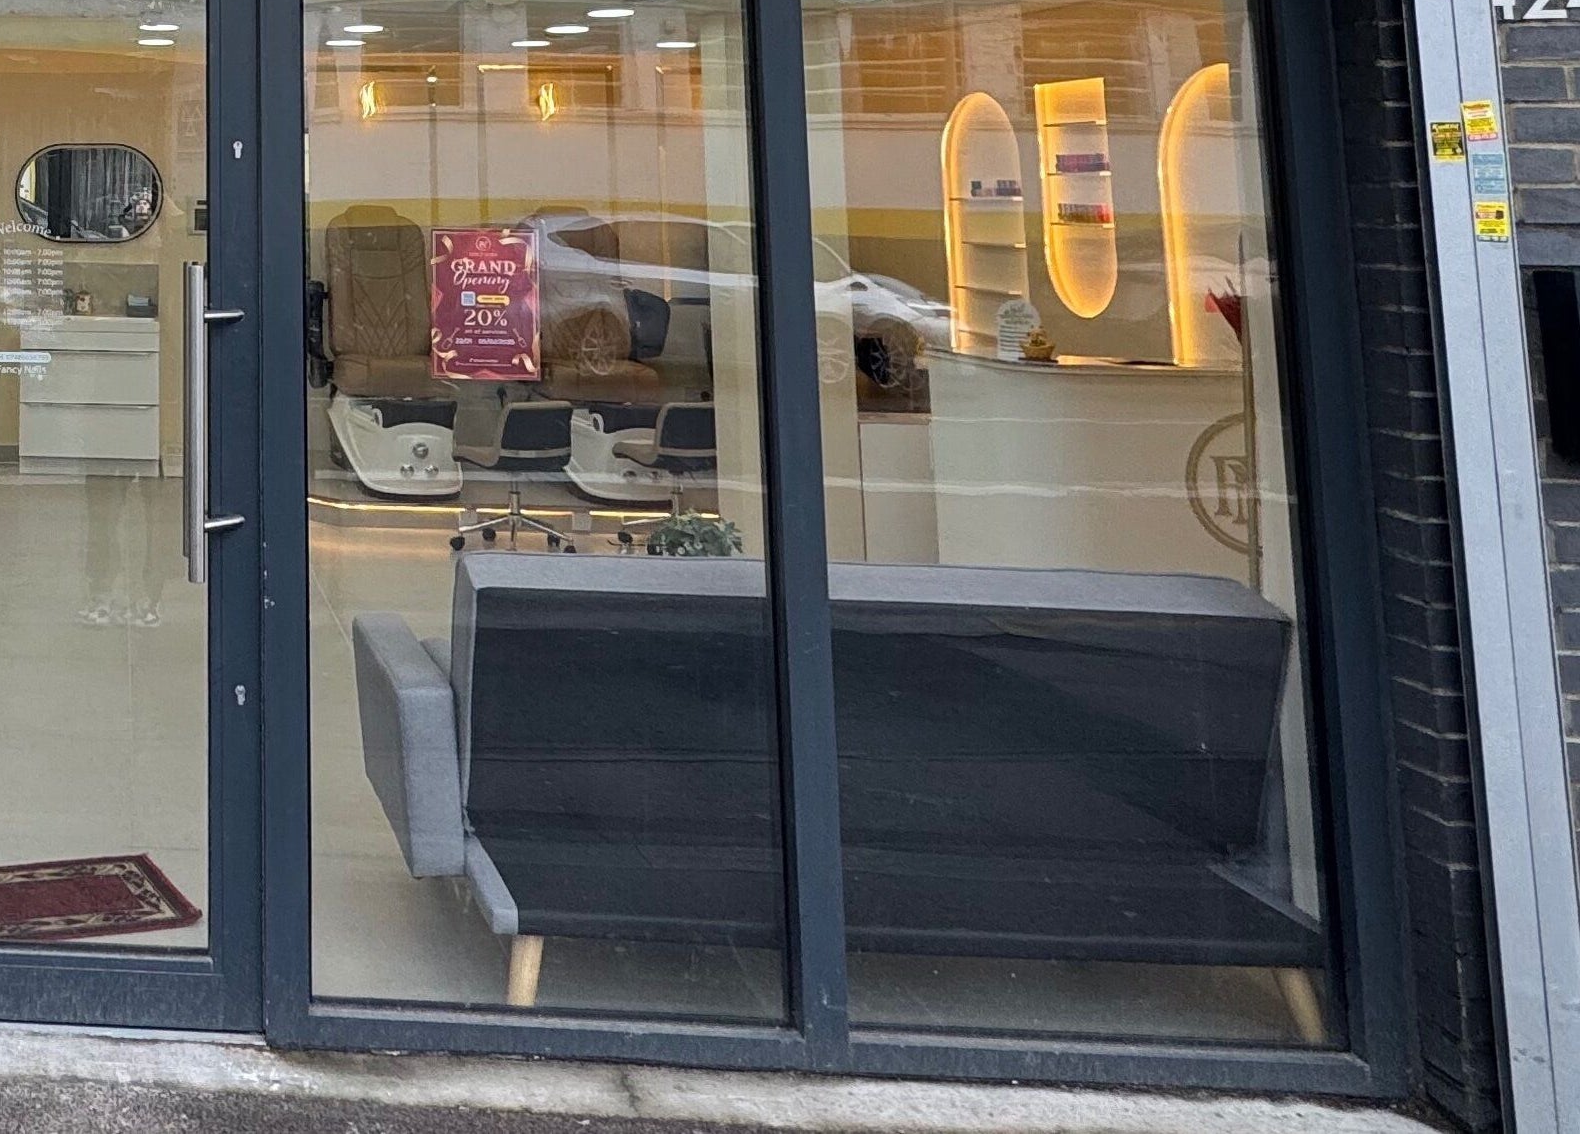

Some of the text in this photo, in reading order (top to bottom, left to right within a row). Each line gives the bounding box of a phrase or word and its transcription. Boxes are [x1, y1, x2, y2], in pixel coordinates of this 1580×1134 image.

[451, 257, 516, 275] GRAND
[454, 270, 510, 293] Opening
[464, 309, 508, 327] 20%
